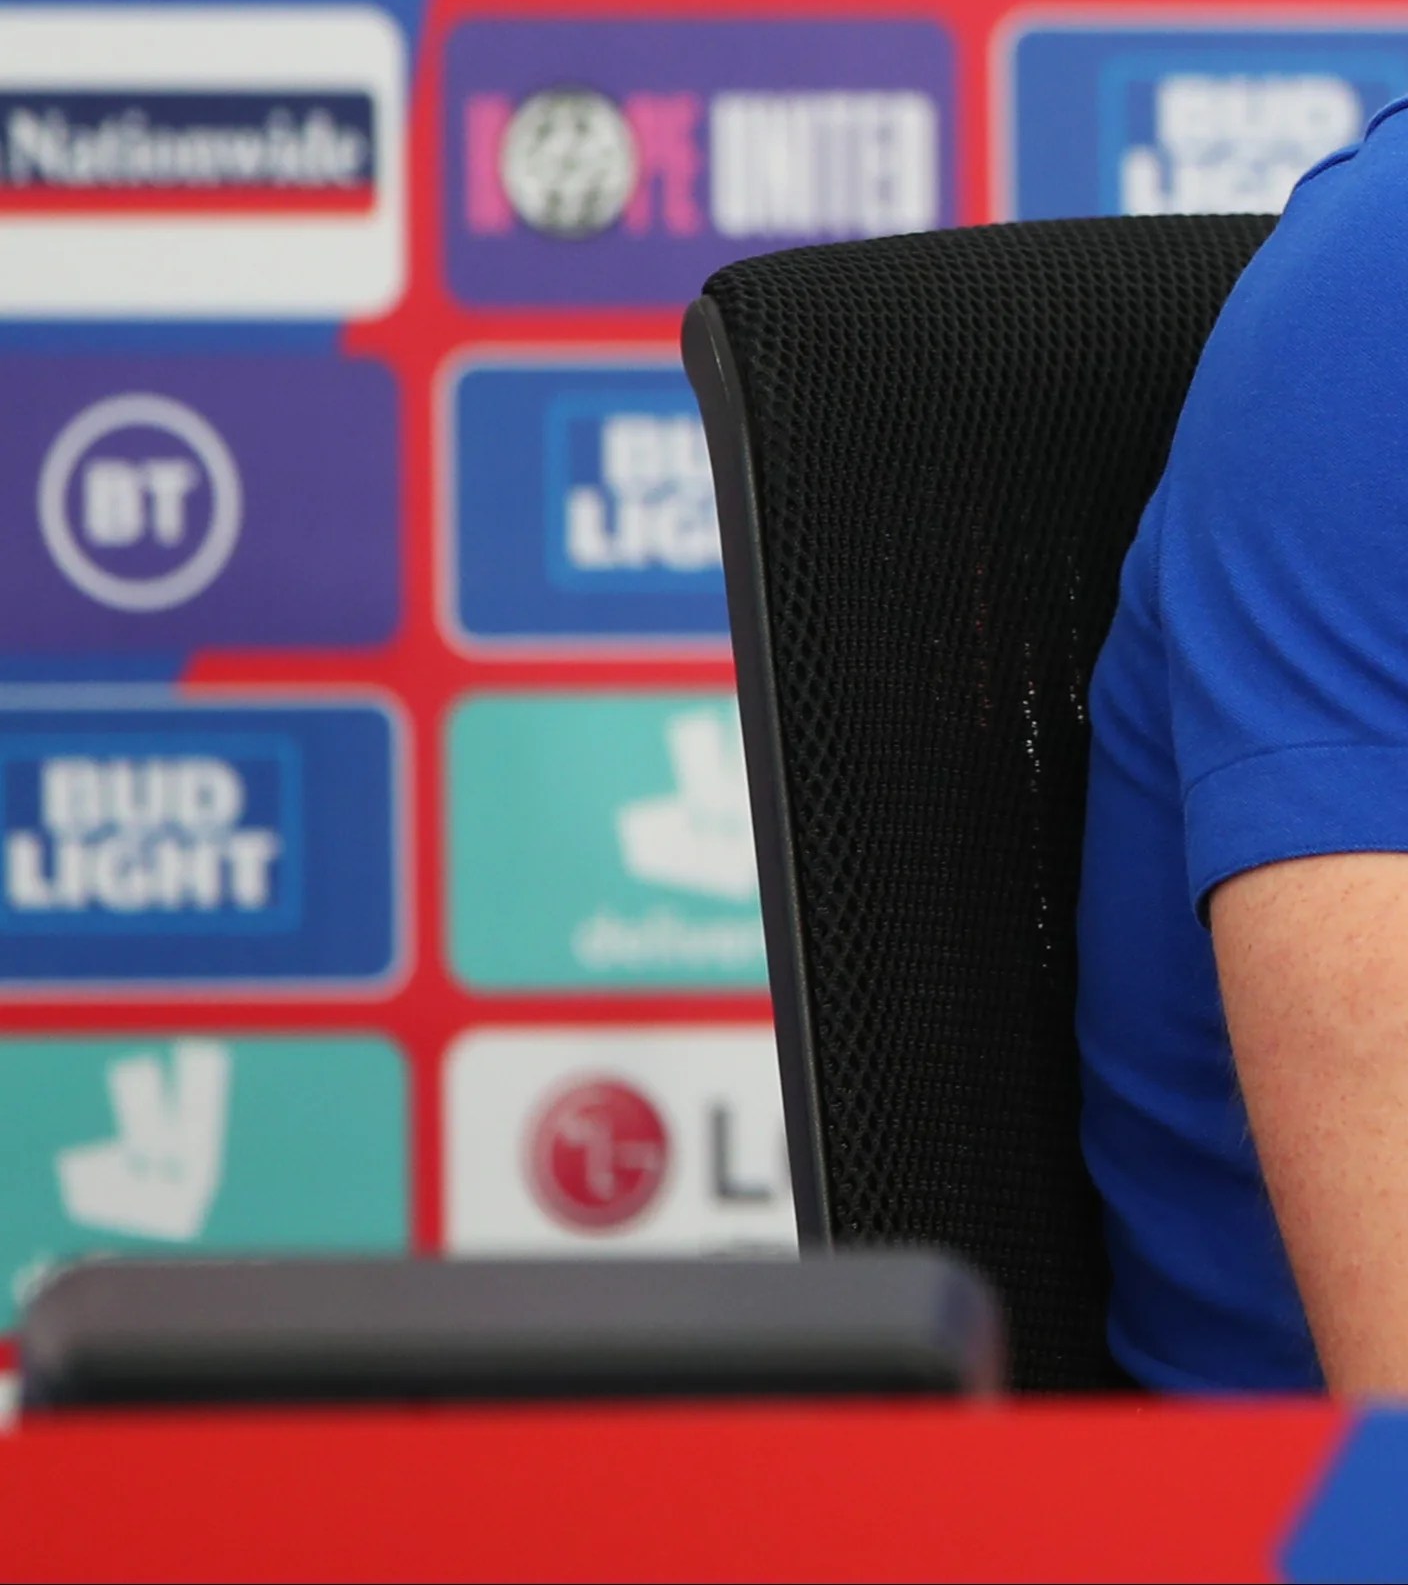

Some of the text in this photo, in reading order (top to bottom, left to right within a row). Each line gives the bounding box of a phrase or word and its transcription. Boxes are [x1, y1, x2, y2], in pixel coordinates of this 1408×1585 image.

[5, 105, 363, 189] Nationwide
[1156, 75, 1362, 146] BUD
[711, 91, 937, 238] UNITED
[84, 460, 196, 547] BT
[43, 757, 244, 826] BUD
[7, 826, 281, 910] LIGHT
